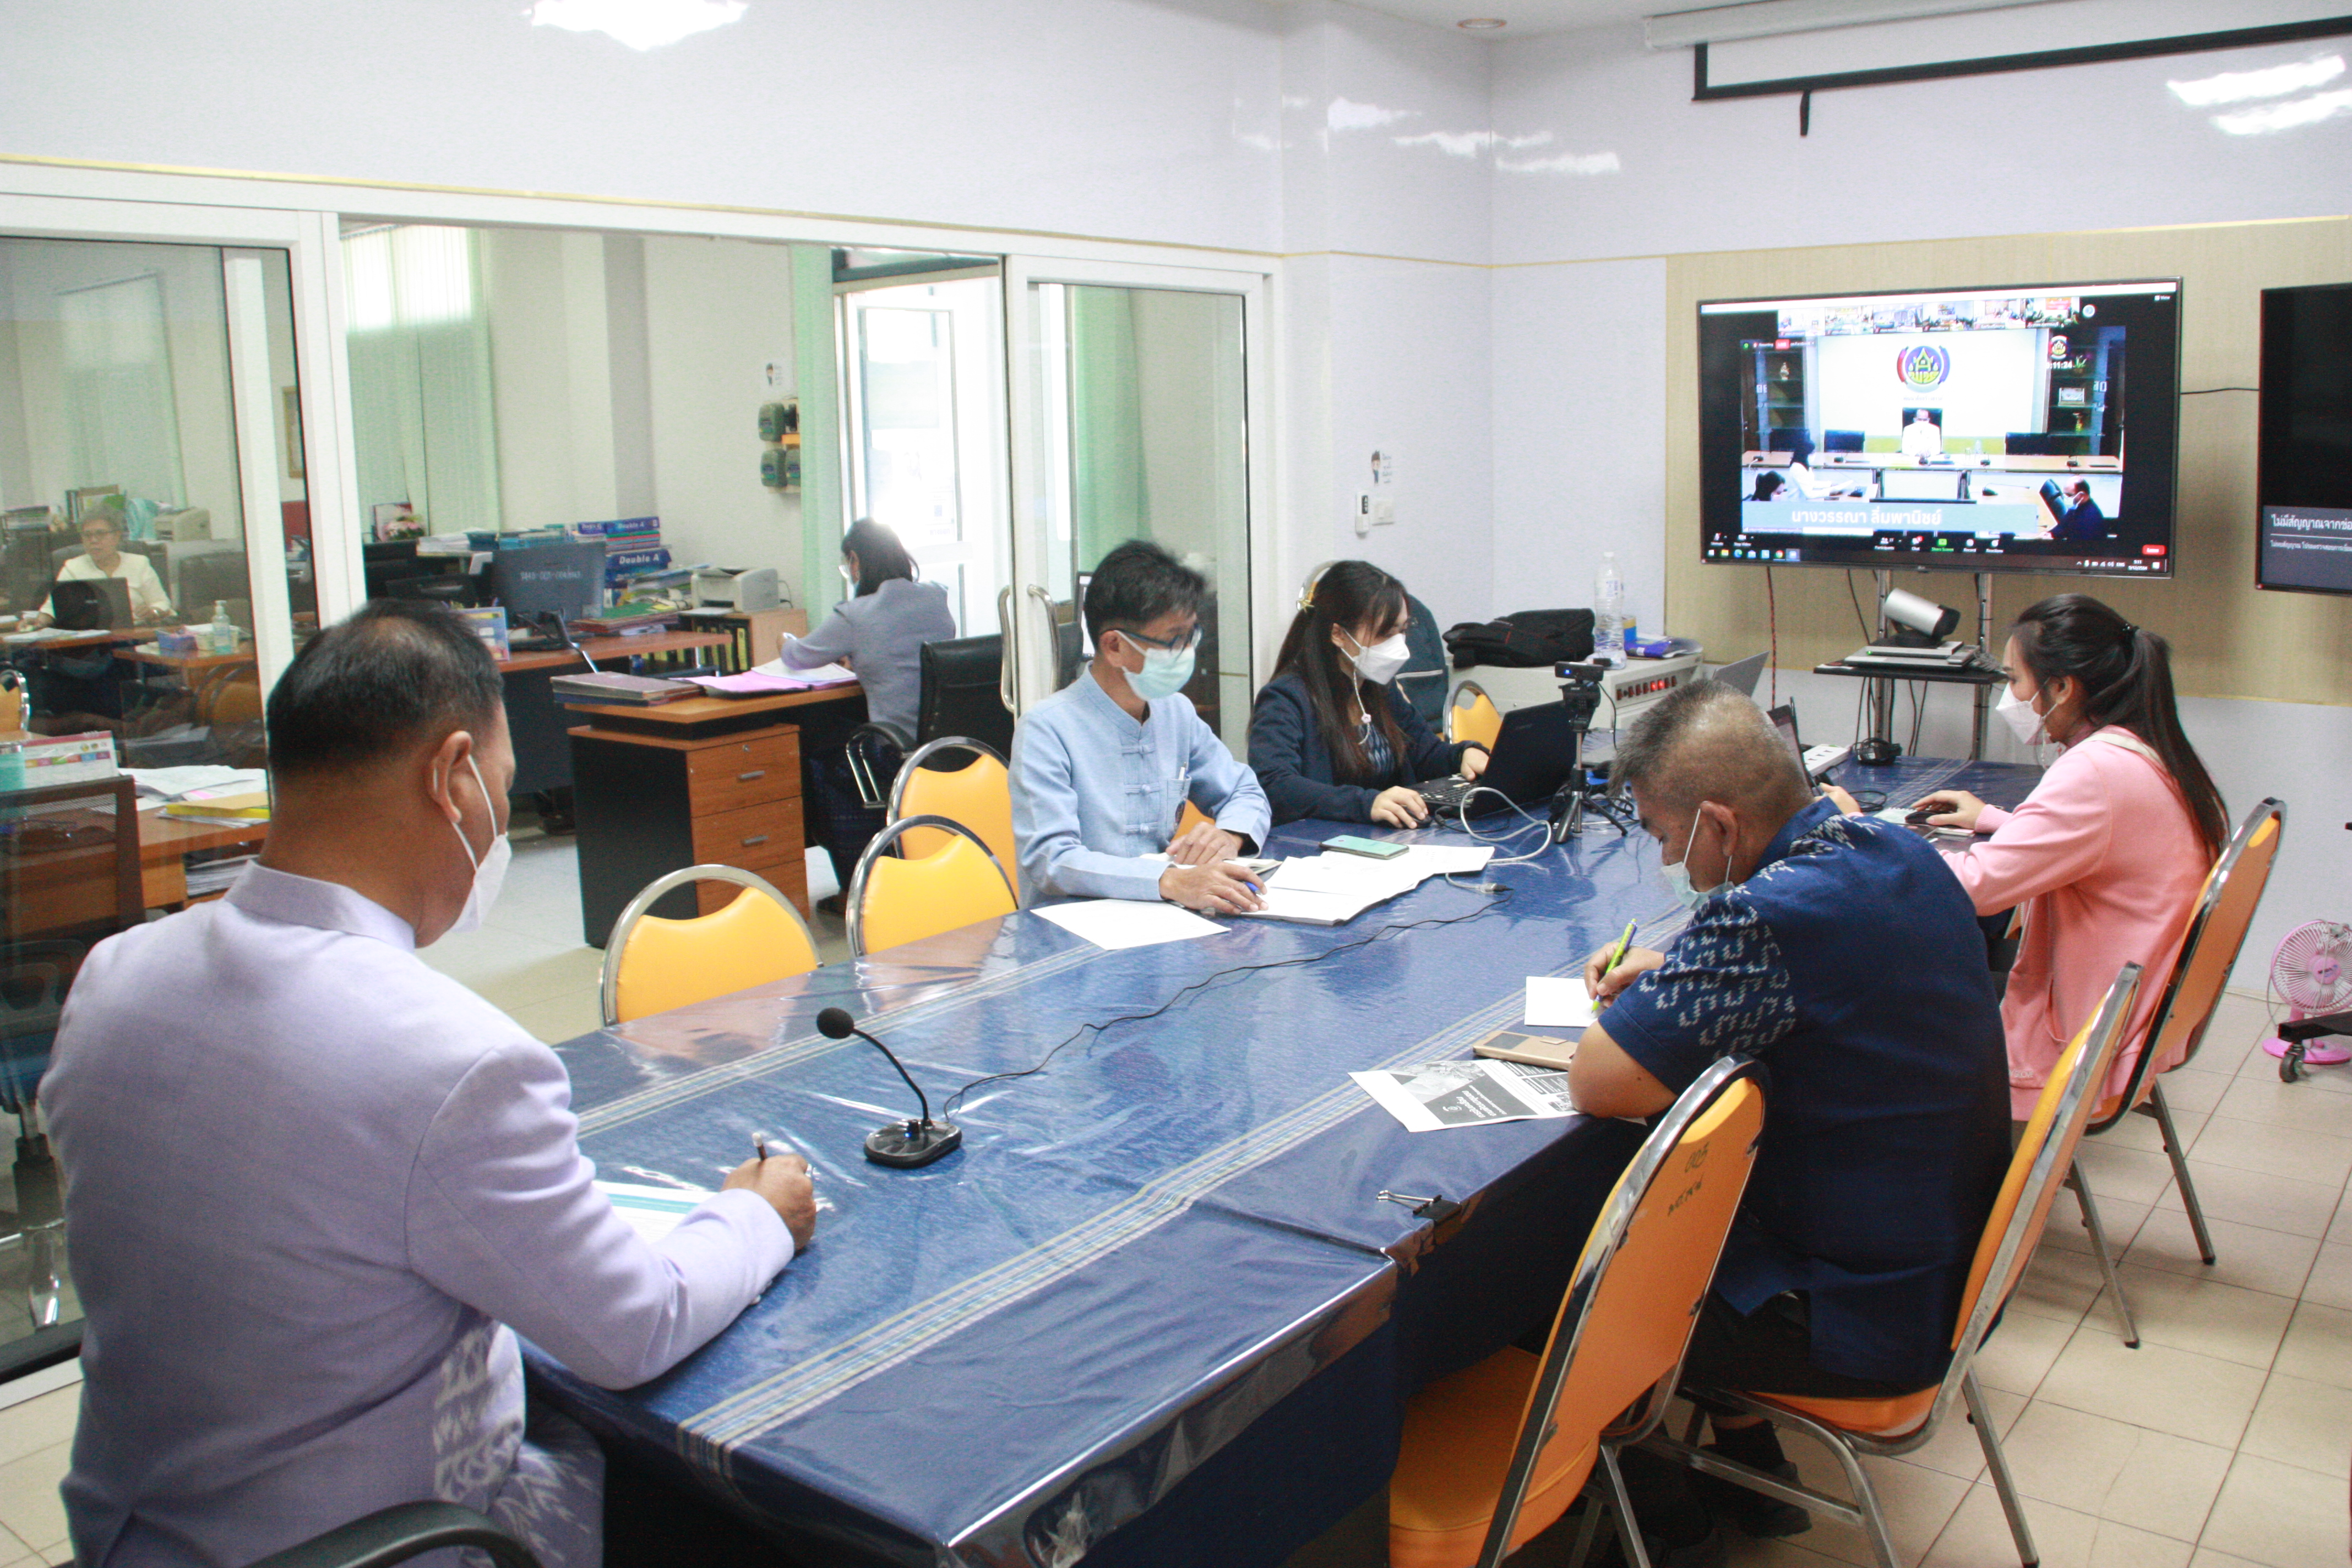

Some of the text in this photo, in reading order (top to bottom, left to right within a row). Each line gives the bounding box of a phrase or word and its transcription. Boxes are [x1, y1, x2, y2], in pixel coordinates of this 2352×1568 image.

[1792, 510, 1866, 523] นางวรรณา
[619, 553, 660, 564] Double A
